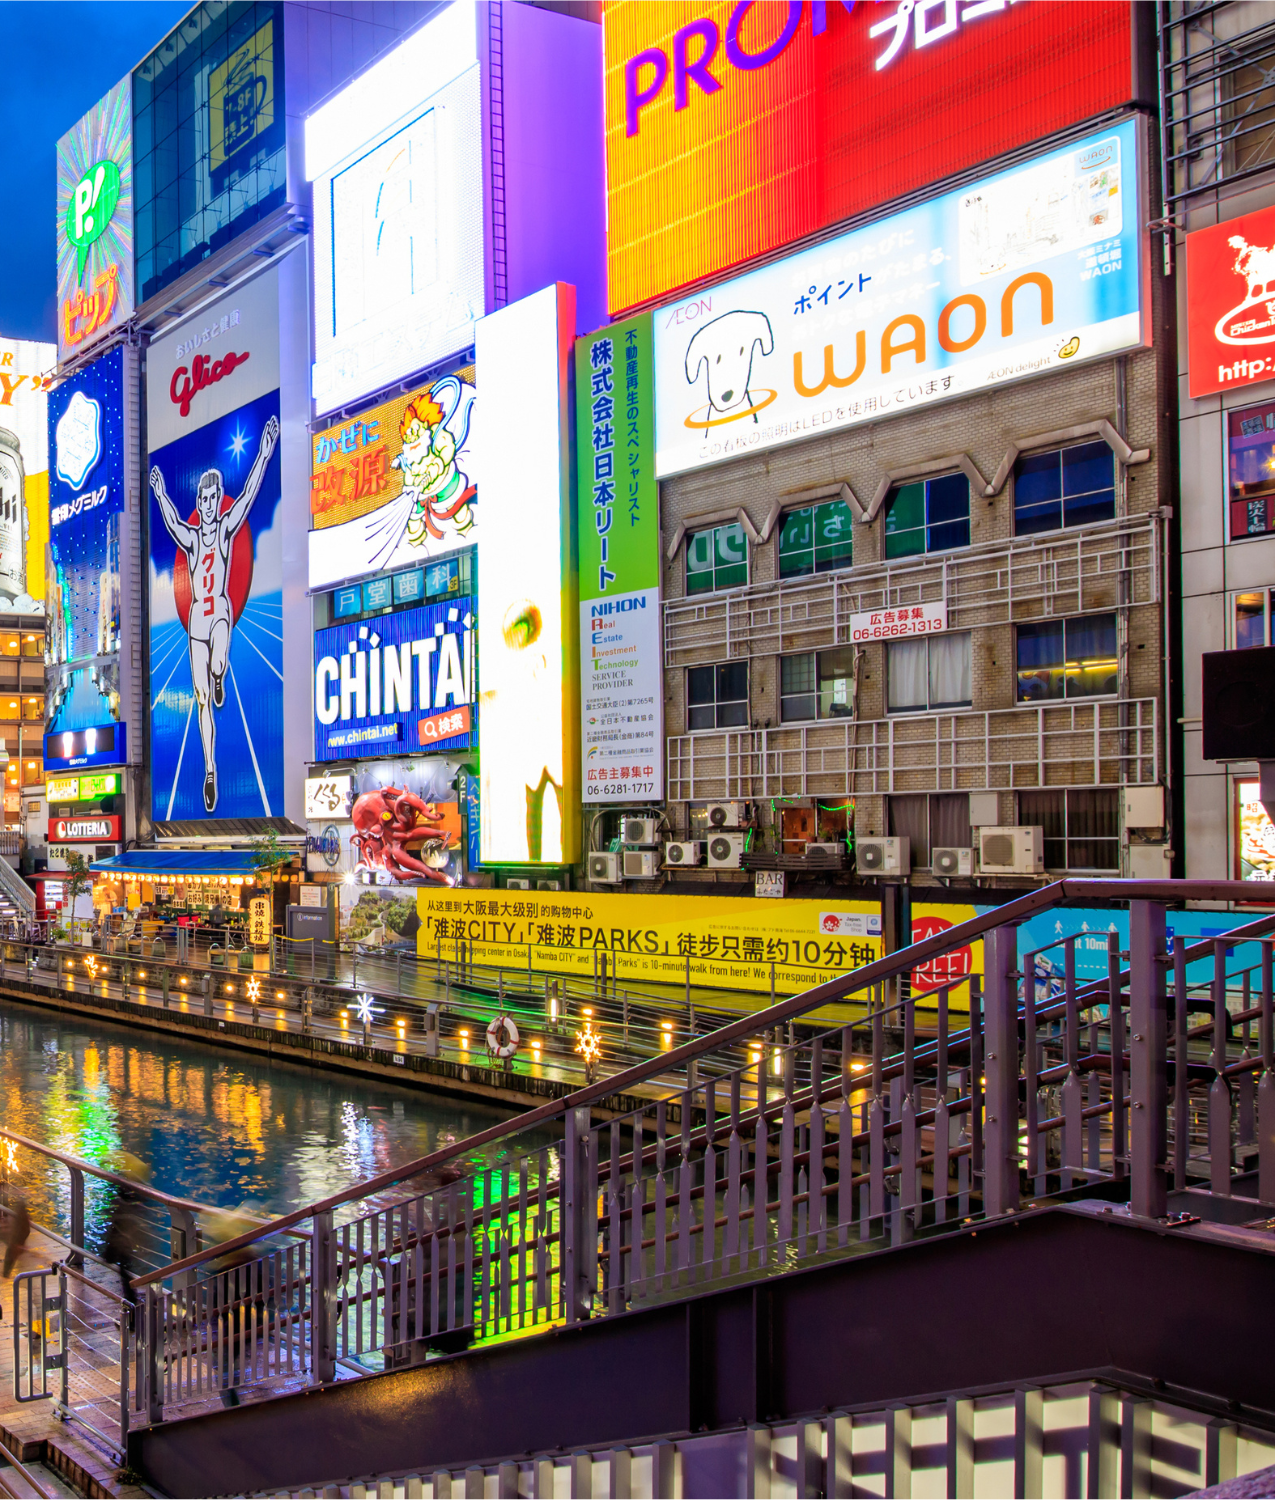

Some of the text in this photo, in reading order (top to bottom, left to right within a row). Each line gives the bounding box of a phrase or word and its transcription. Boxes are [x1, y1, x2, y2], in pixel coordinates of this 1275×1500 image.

[1080, 260, 1122, 282] WAON
[64, 264, 117, 345] ピップ
[176, 309, 240, 359] おいしさと健康
[1015, 357, 1051, 372] delight
[170, 352, 250, 417] Glico
[625, 328, 640, 527] 不動産再生のスペシャリスト
[315, 419, 380, 464] かぜに
[591, 338, 616, 591] 株式会社日本リート
[310, 446, 390, 516] 改源
[51, 485, 107, 526] 雪印メグミルク
[201, 548, 217, 617] グリコ
[591, 596, 646, 617] NIHON
[870, 607, 923, 625] 広告募集
[592, 618, 615, 631] Real
[853, 619, 942, 640] 06-6262-1313
[592, 632, 623, 644] Estate
[592, 645, 636, 658] Investment
[591, 659, 638, 671] Technology
[592, 670, 626, 682] SERVICE
[592, 679, 633, 691] PROVIDER
[438, 714, 463, 735] 検索
[600, 714, 654, 725] 全日本不動産協会
[587, 765, 654, 781] 広告主募集中
[460, 776, 466, 803] 2F
[587, 783, 654, 795] 06-6281-1717
[66, 821, 108, 836] LOTTERIA
[756, 873, 783, 885] BAR
[487, 947, 505, 957] center
[506, 949, 512, 957] in
[577, 954, 589, 964] and
[642, 959, 649, 969] is
[690, 963, 707, 974] walk
[709, 965, 728, 976] from
[730, 967, 751, 977] here!
[753, 968, 766, 978] We
